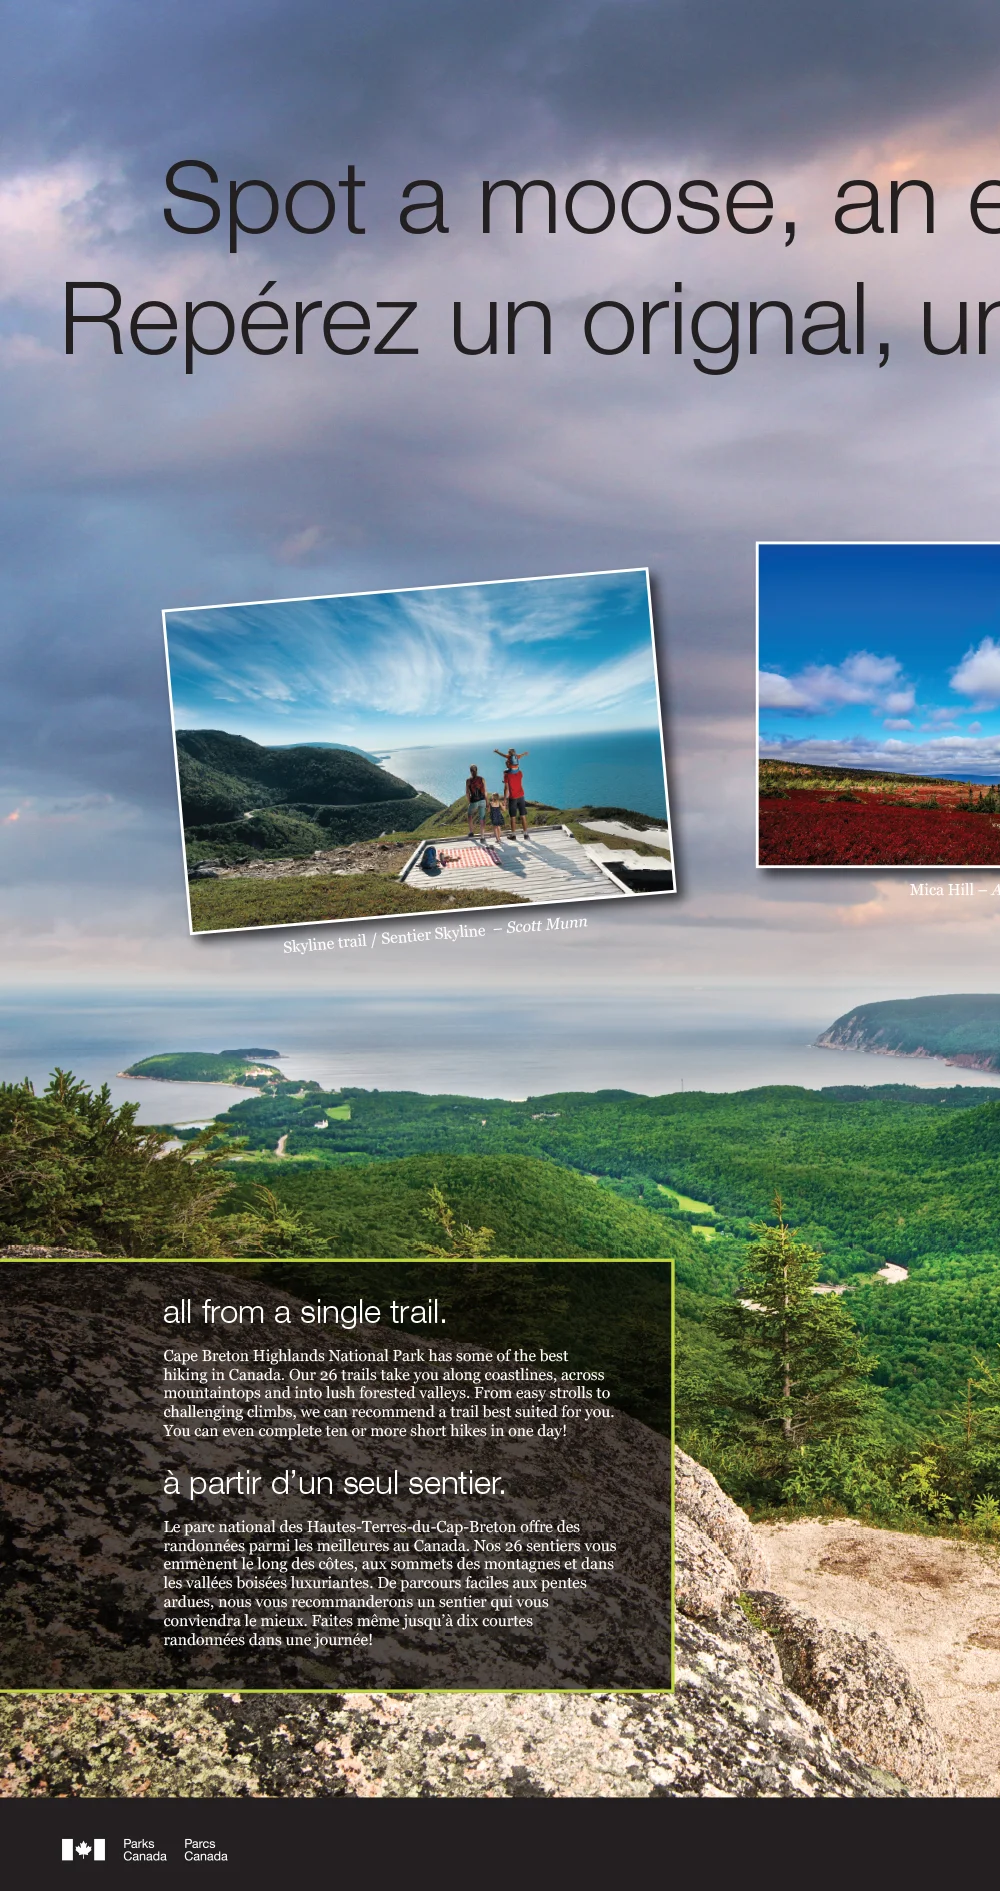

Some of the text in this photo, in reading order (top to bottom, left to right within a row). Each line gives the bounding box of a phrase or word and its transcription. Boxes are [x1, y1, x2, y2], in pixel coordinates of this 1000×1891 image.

[163, 159, 366, 254] Spot
[399, 179, 450, 235] a
[482, 179, 795, 248] moose,
[834, 179, 934, 235] an
[65, 280, 419, 375] Repérez
[453, 300, 552, 356] un
[584, 281, 890, 376] orignal,
[909, 882, 945, 897] Mica
[947, 882, 975, 896] Hill
[283, 916, 589, 955] Skyline trail Sentier Skyline Scott Munn
[163, 1298, 446, 1330] all from a single trail.
[163, 1348, 569, 1366] Cape Breton Highlands National Park has some of the best
[163, 1367, 605, 1385] hiking in Canada. Our 26 trails take you along coastlines, across
[163, 1385, 611, 1402] mountaintops and into lush forested valleys. From easy strolls to
[162, 1423, 567, 1440] You can even complete ten or more short hikes in one day!
[163, 1469, 181, 1495] à
[190, 1469, 262, 1501] partir
[343, 1469, 398, 1495] seul
[408, 1469, 505, 1495] sentier.
[164, 1519, 580, 1537] Le parc national des Hautes-Terres-du-Cap-Breton offre des
[163, 1538, 617, 1555] randonnées parmi les meilleures au Canada. Nos 26 sentiers vous
[163, 1556, 614, 1574] emmènent le long des côtes, aux sommets des montagnes et dans
[163, 1594, 549, 1612] ardues, nous vous recommanderons un sentier qui vous
[163, 1613, 242, 1627] conviendra
[244, 1613, 257, 1627] le
[260, 1613, 308, 1627] mieux.
[311, 1614, 353, 1627] Faites
[357, 1613, 400, 1627] même
[456, 1613, 479, 1627] dix
[482, 1615, 534, 1627] courtes
[163, 1632, 373, 1649] randonnées dans une journée!
[123, 1838, 155, 1849] Parks
[184, 1838, 216, 1849] Parcs
[123, 1850, 167, 1862] Canada
[184, 1850, 228, 1862] Canada
